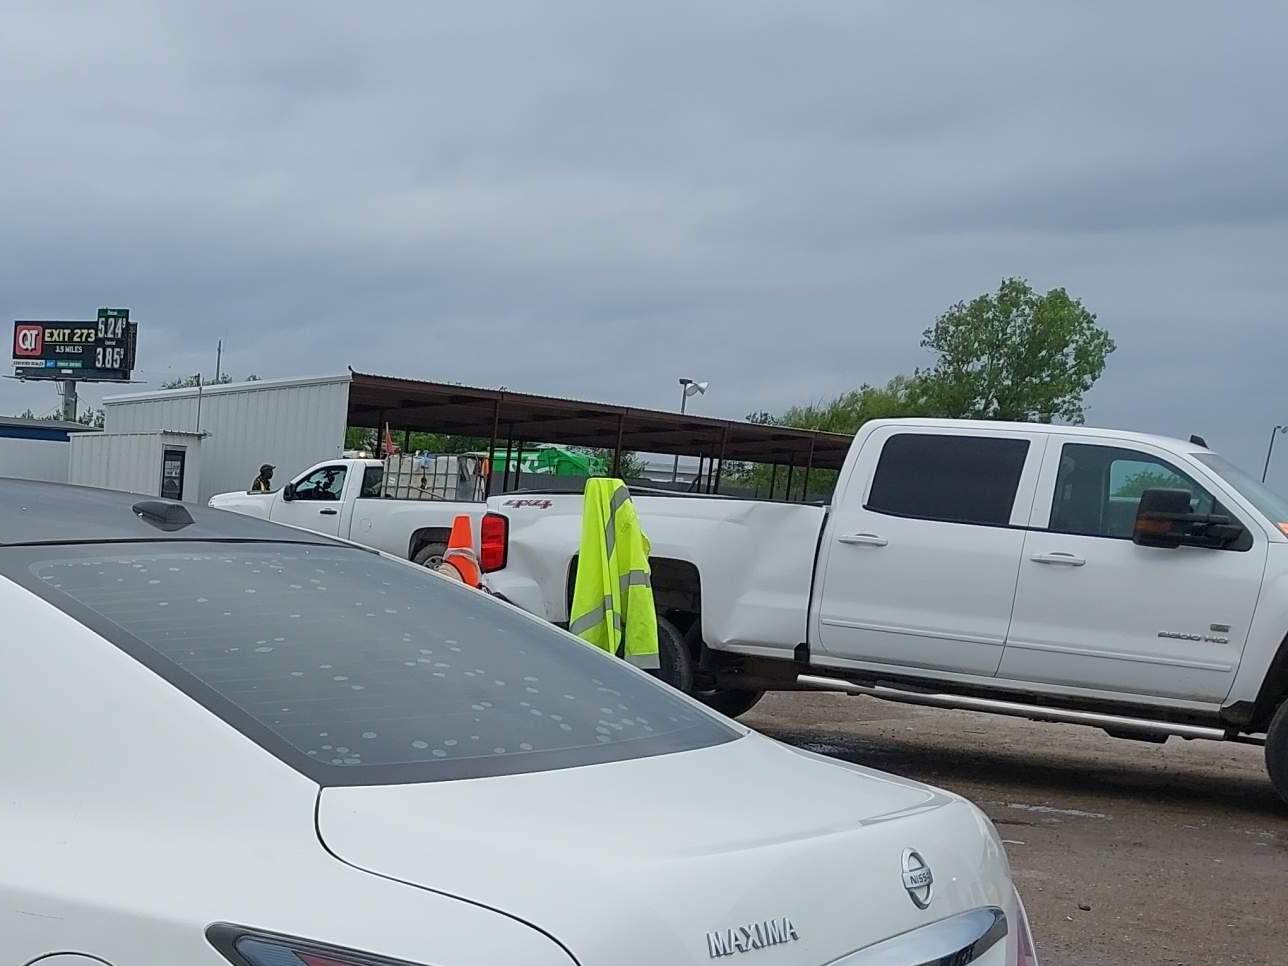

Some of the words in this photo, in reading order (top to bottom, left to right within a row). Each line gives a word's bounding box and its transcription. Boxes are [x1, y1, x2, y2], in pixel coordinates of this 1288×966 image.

[19, 330, 38, 350] QT
[45, 329, 71, 341] EXIT
[73, 330, 95, 341] 273
[65, 345, 83, 353] MILES
[706, 917, 800, 959] MAXIMA
